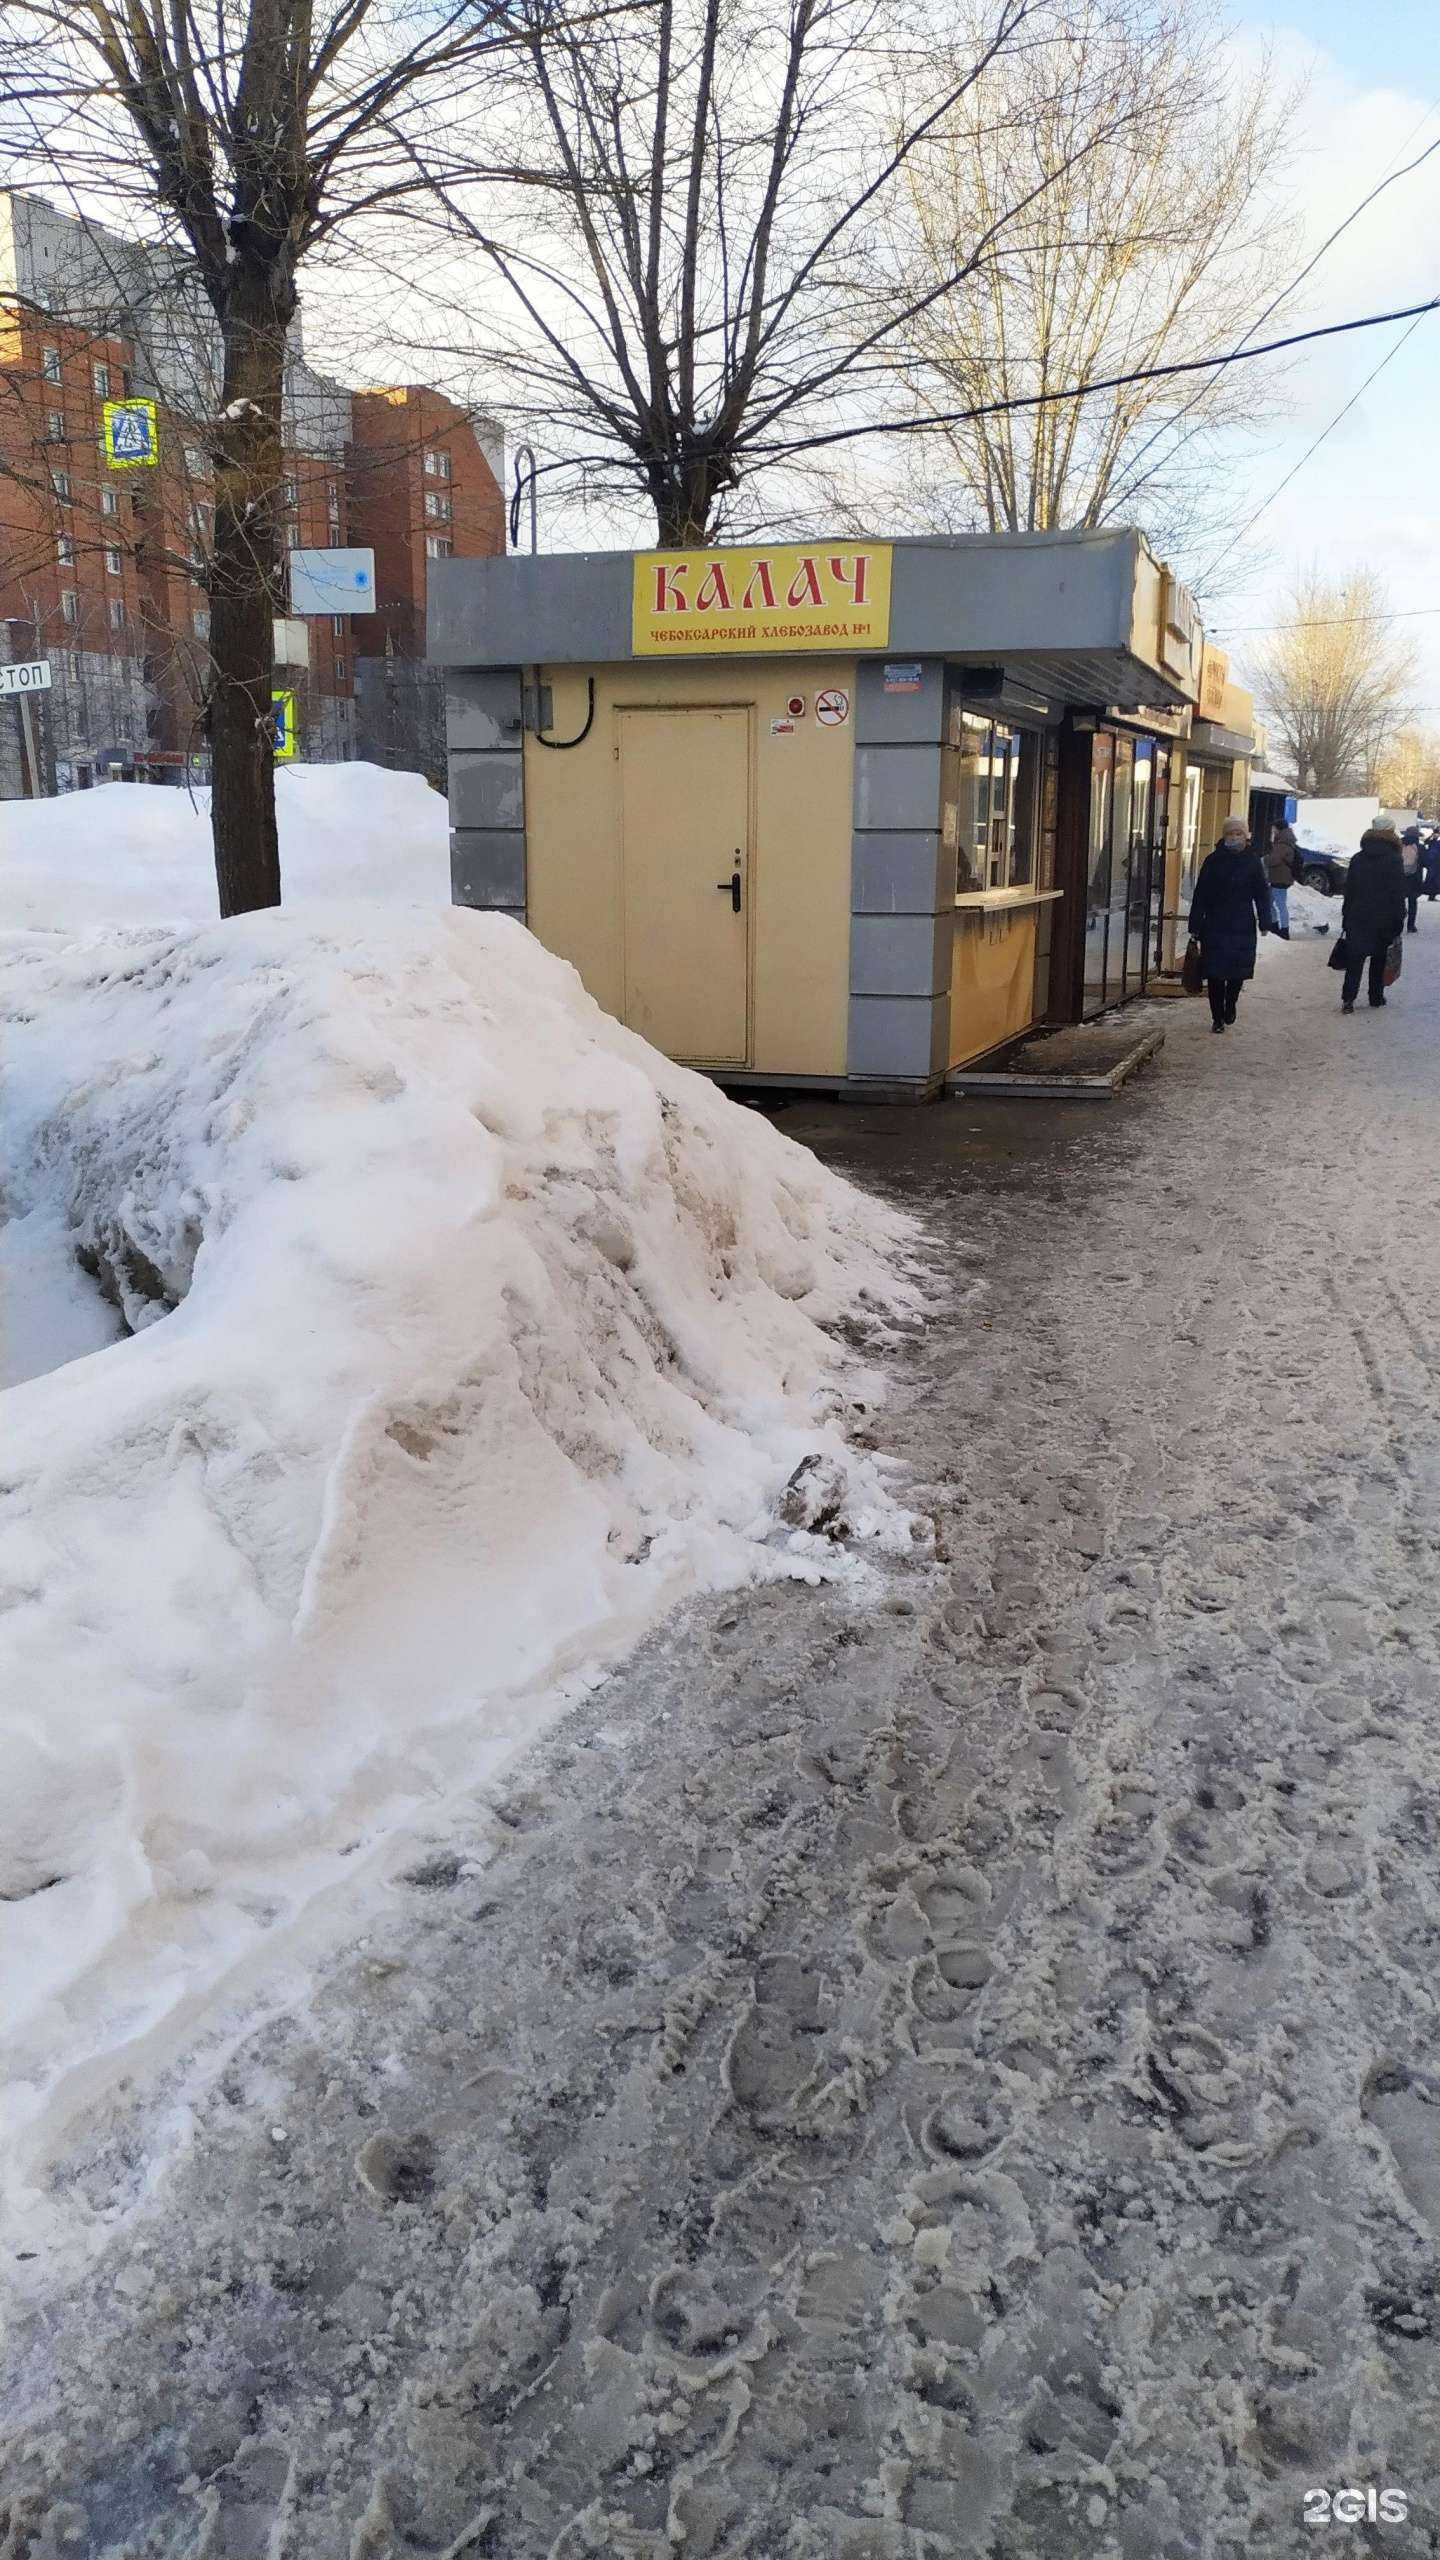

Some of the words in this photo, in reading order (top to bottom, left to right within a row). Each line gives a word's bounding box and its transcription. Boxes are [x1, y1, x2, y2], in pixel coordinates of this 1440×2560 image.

[652, 555, 871, 612] КАЛАЧ
[650, 624, 756, 641] ЧЕБОКСАРСКИЙ
[761, 624, 848, 638] ХЛЕБОЗАВОД
